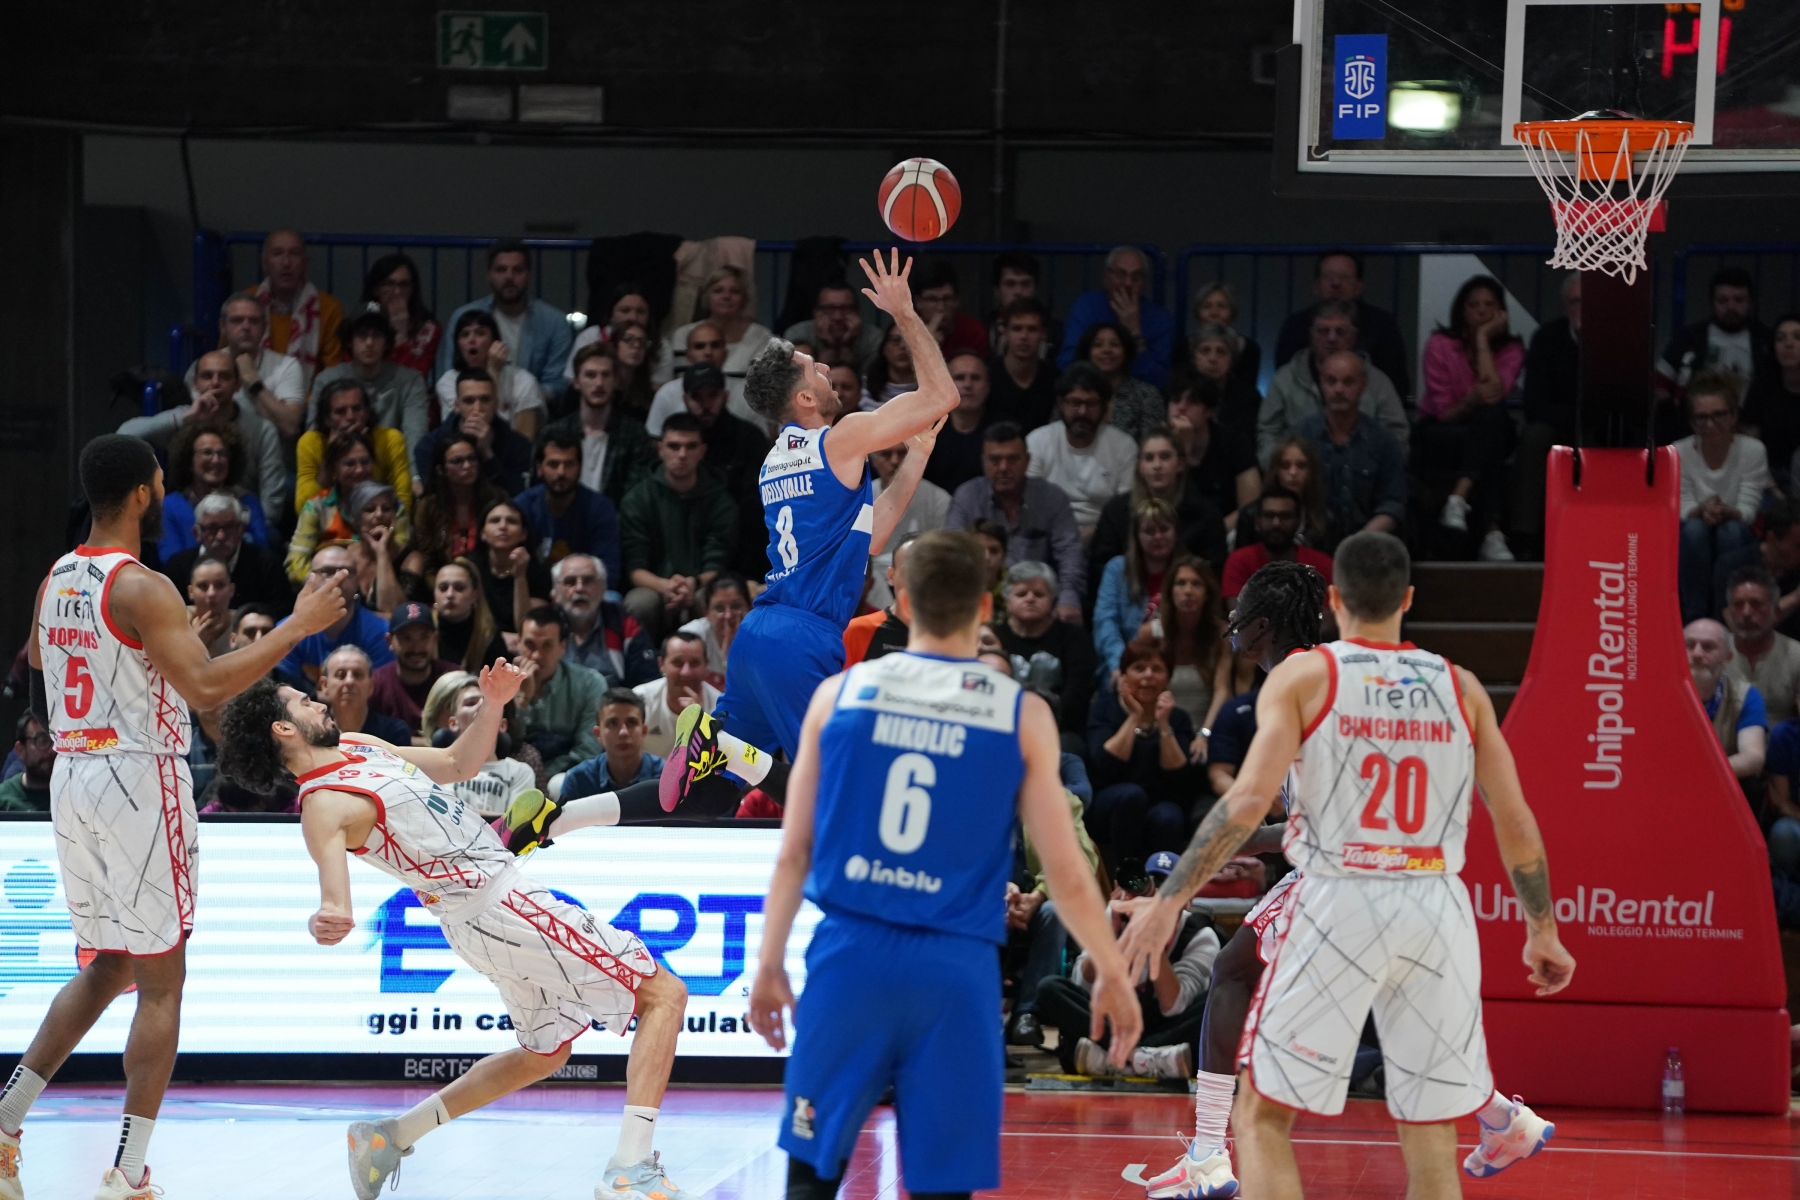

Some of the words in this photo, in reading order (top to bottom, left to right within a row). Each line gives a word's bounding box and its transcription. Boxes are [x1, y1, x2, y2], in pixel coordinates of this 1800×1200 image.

[1338, 103, 1381, 119] FIP
[775, 505, 799, 569] 8
[1627, 532, 1638, 578] TERMINE
[1627, 579, 1638, 617] LUNGO
[48, 626, 99, 650] HOPINS
[1629, 617, 1638, 626] A
[1627, 627, 1638, 680] NOLEGGIO
[63, 656, 94, 719] 5
[872, 712, 967, 758] NIKOLIC
[1338, 714, 1453, 744] CINCIARINI
[878, 752, 937, 855] 6
[1360, 751, 1428, 835] 20
[1344, 845, 1408, 869] Tonogen
[1406, 857, 1445, 871] PLUS
[870, 859, 943, 894] inblu
[1475, 883, 1714, 926] UnolRental
[1588, 925, 1643, 937] NOLEGGIO
[1645, 926, 1654, 937] A
[1655, 926, 1694, 939] LUNGO
[1696, 927, 1744, 940] TERMINE
[432, 1007, 463, 1031] in
[404, 1058, 478, 1078] BERTE
